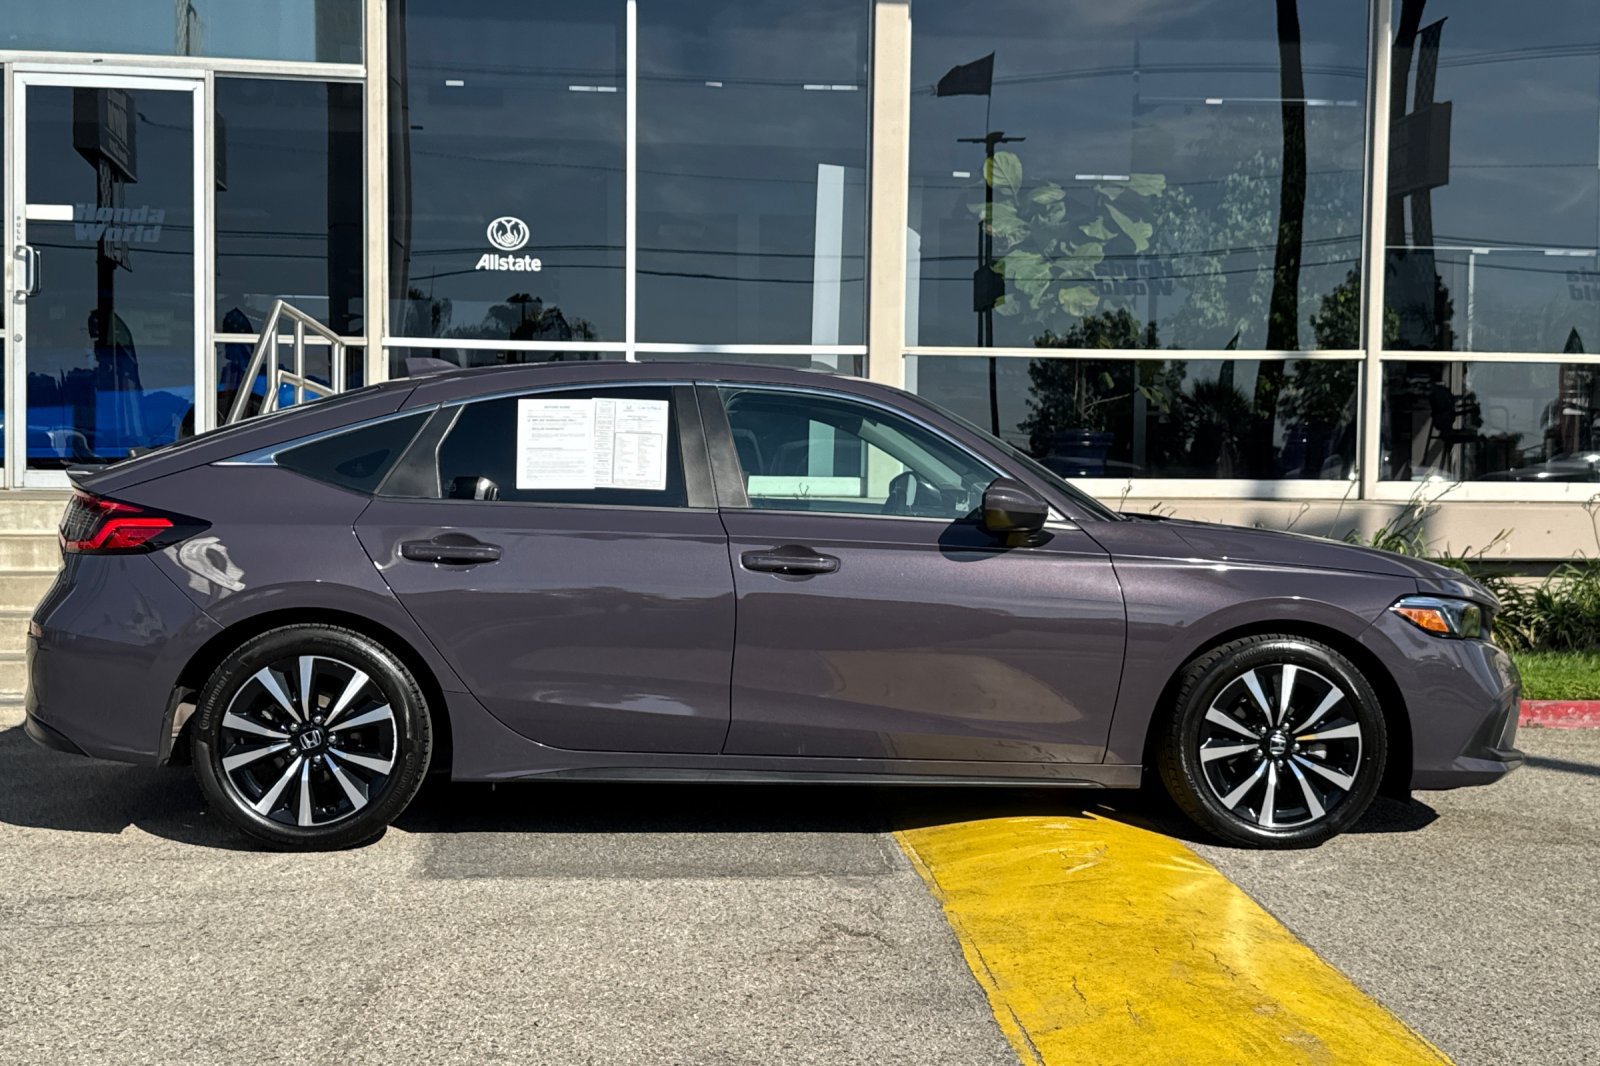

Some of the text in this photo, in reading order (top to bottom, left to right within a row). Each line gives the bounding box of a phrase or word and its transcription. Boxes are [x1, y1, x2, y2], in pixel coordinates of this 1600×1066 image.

[76, 204, 165, 224] Honda
[75, 223, 161, 242] World
[475, 253, 542, 272] Allstate
